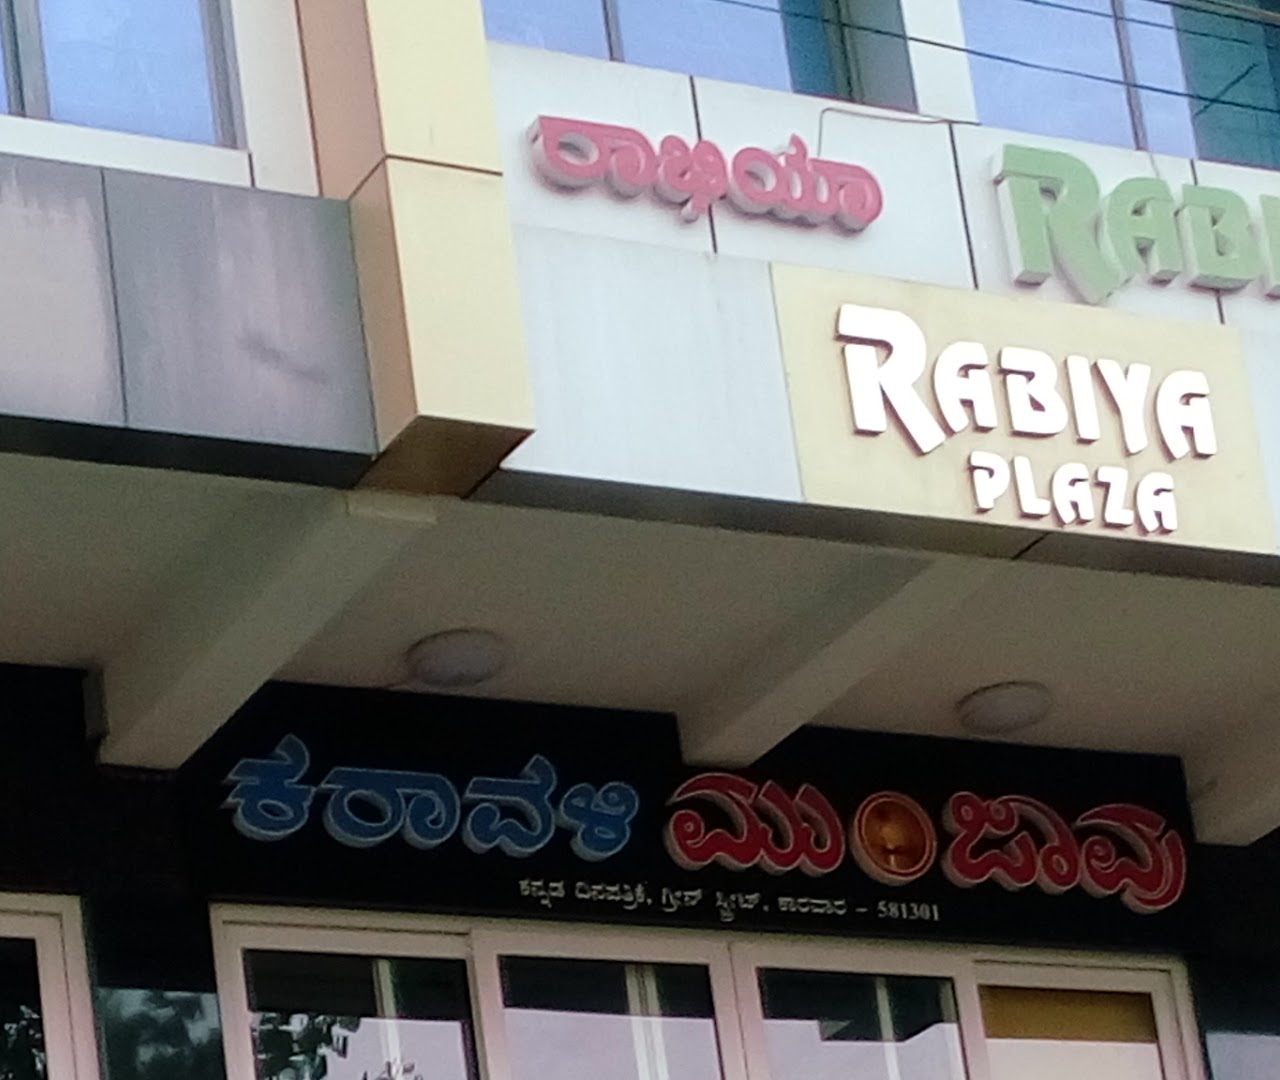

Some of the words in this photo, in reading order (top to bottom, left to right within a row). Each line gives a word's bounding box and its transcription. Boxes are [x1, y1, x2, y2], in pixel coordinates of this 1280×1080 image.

[835, 303, 1219, 460] RABIYA
[969, 451, 1178, 533] PLAZA
[221, 732, 640, 863] ಕರಾವಳಿ
[876, 900, 941, 922] 581301
